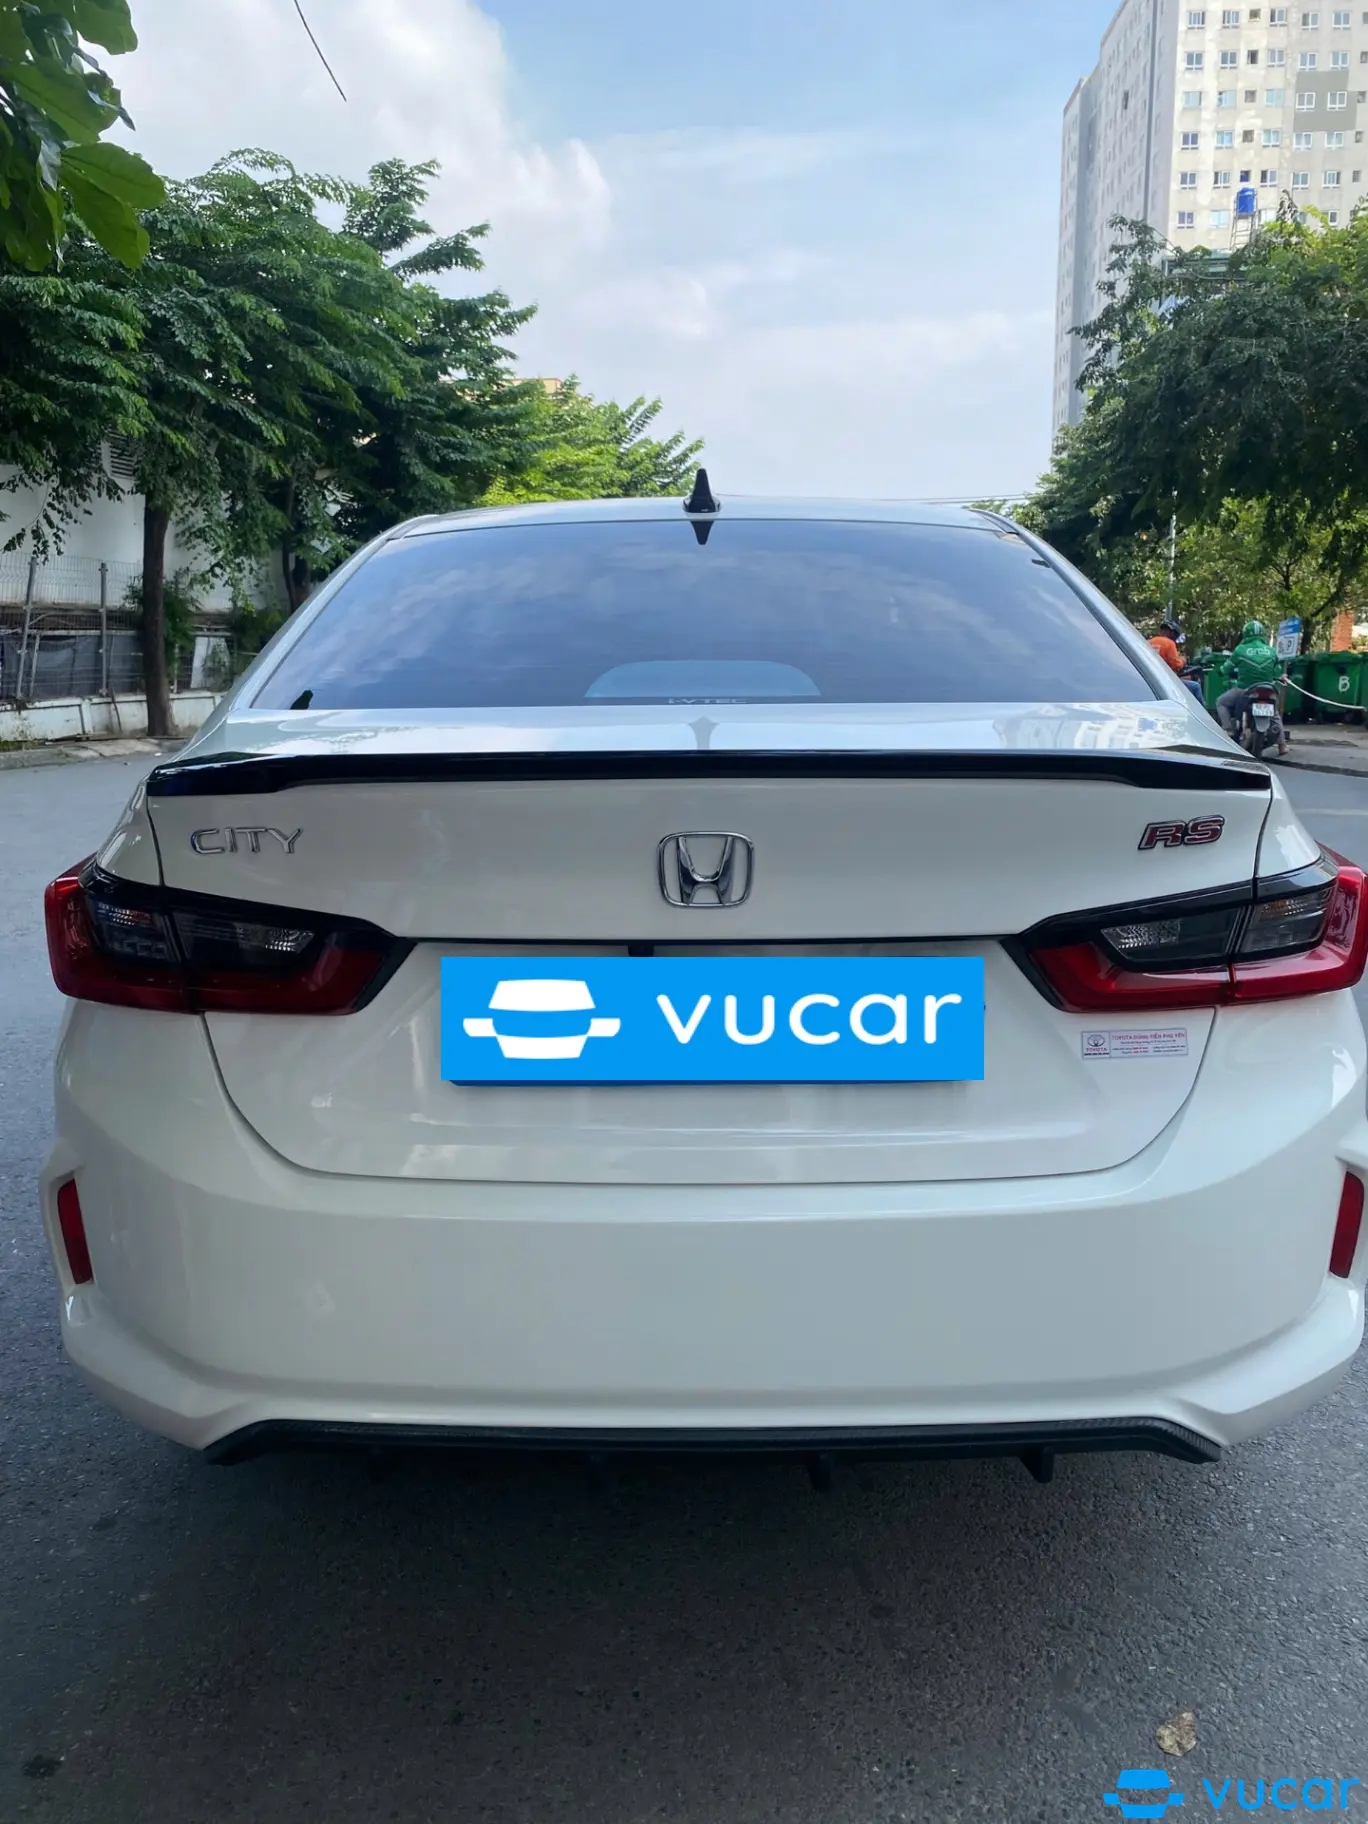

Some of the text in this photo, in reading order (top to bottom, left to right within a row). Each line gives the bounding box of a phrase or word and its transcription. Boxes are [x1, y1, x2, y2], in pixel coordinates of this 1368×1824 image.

[1246, 647, 1271, 656] Grab
[190, 827, 303, 854] CITY
[1138, 815, 1225, 850] RS
